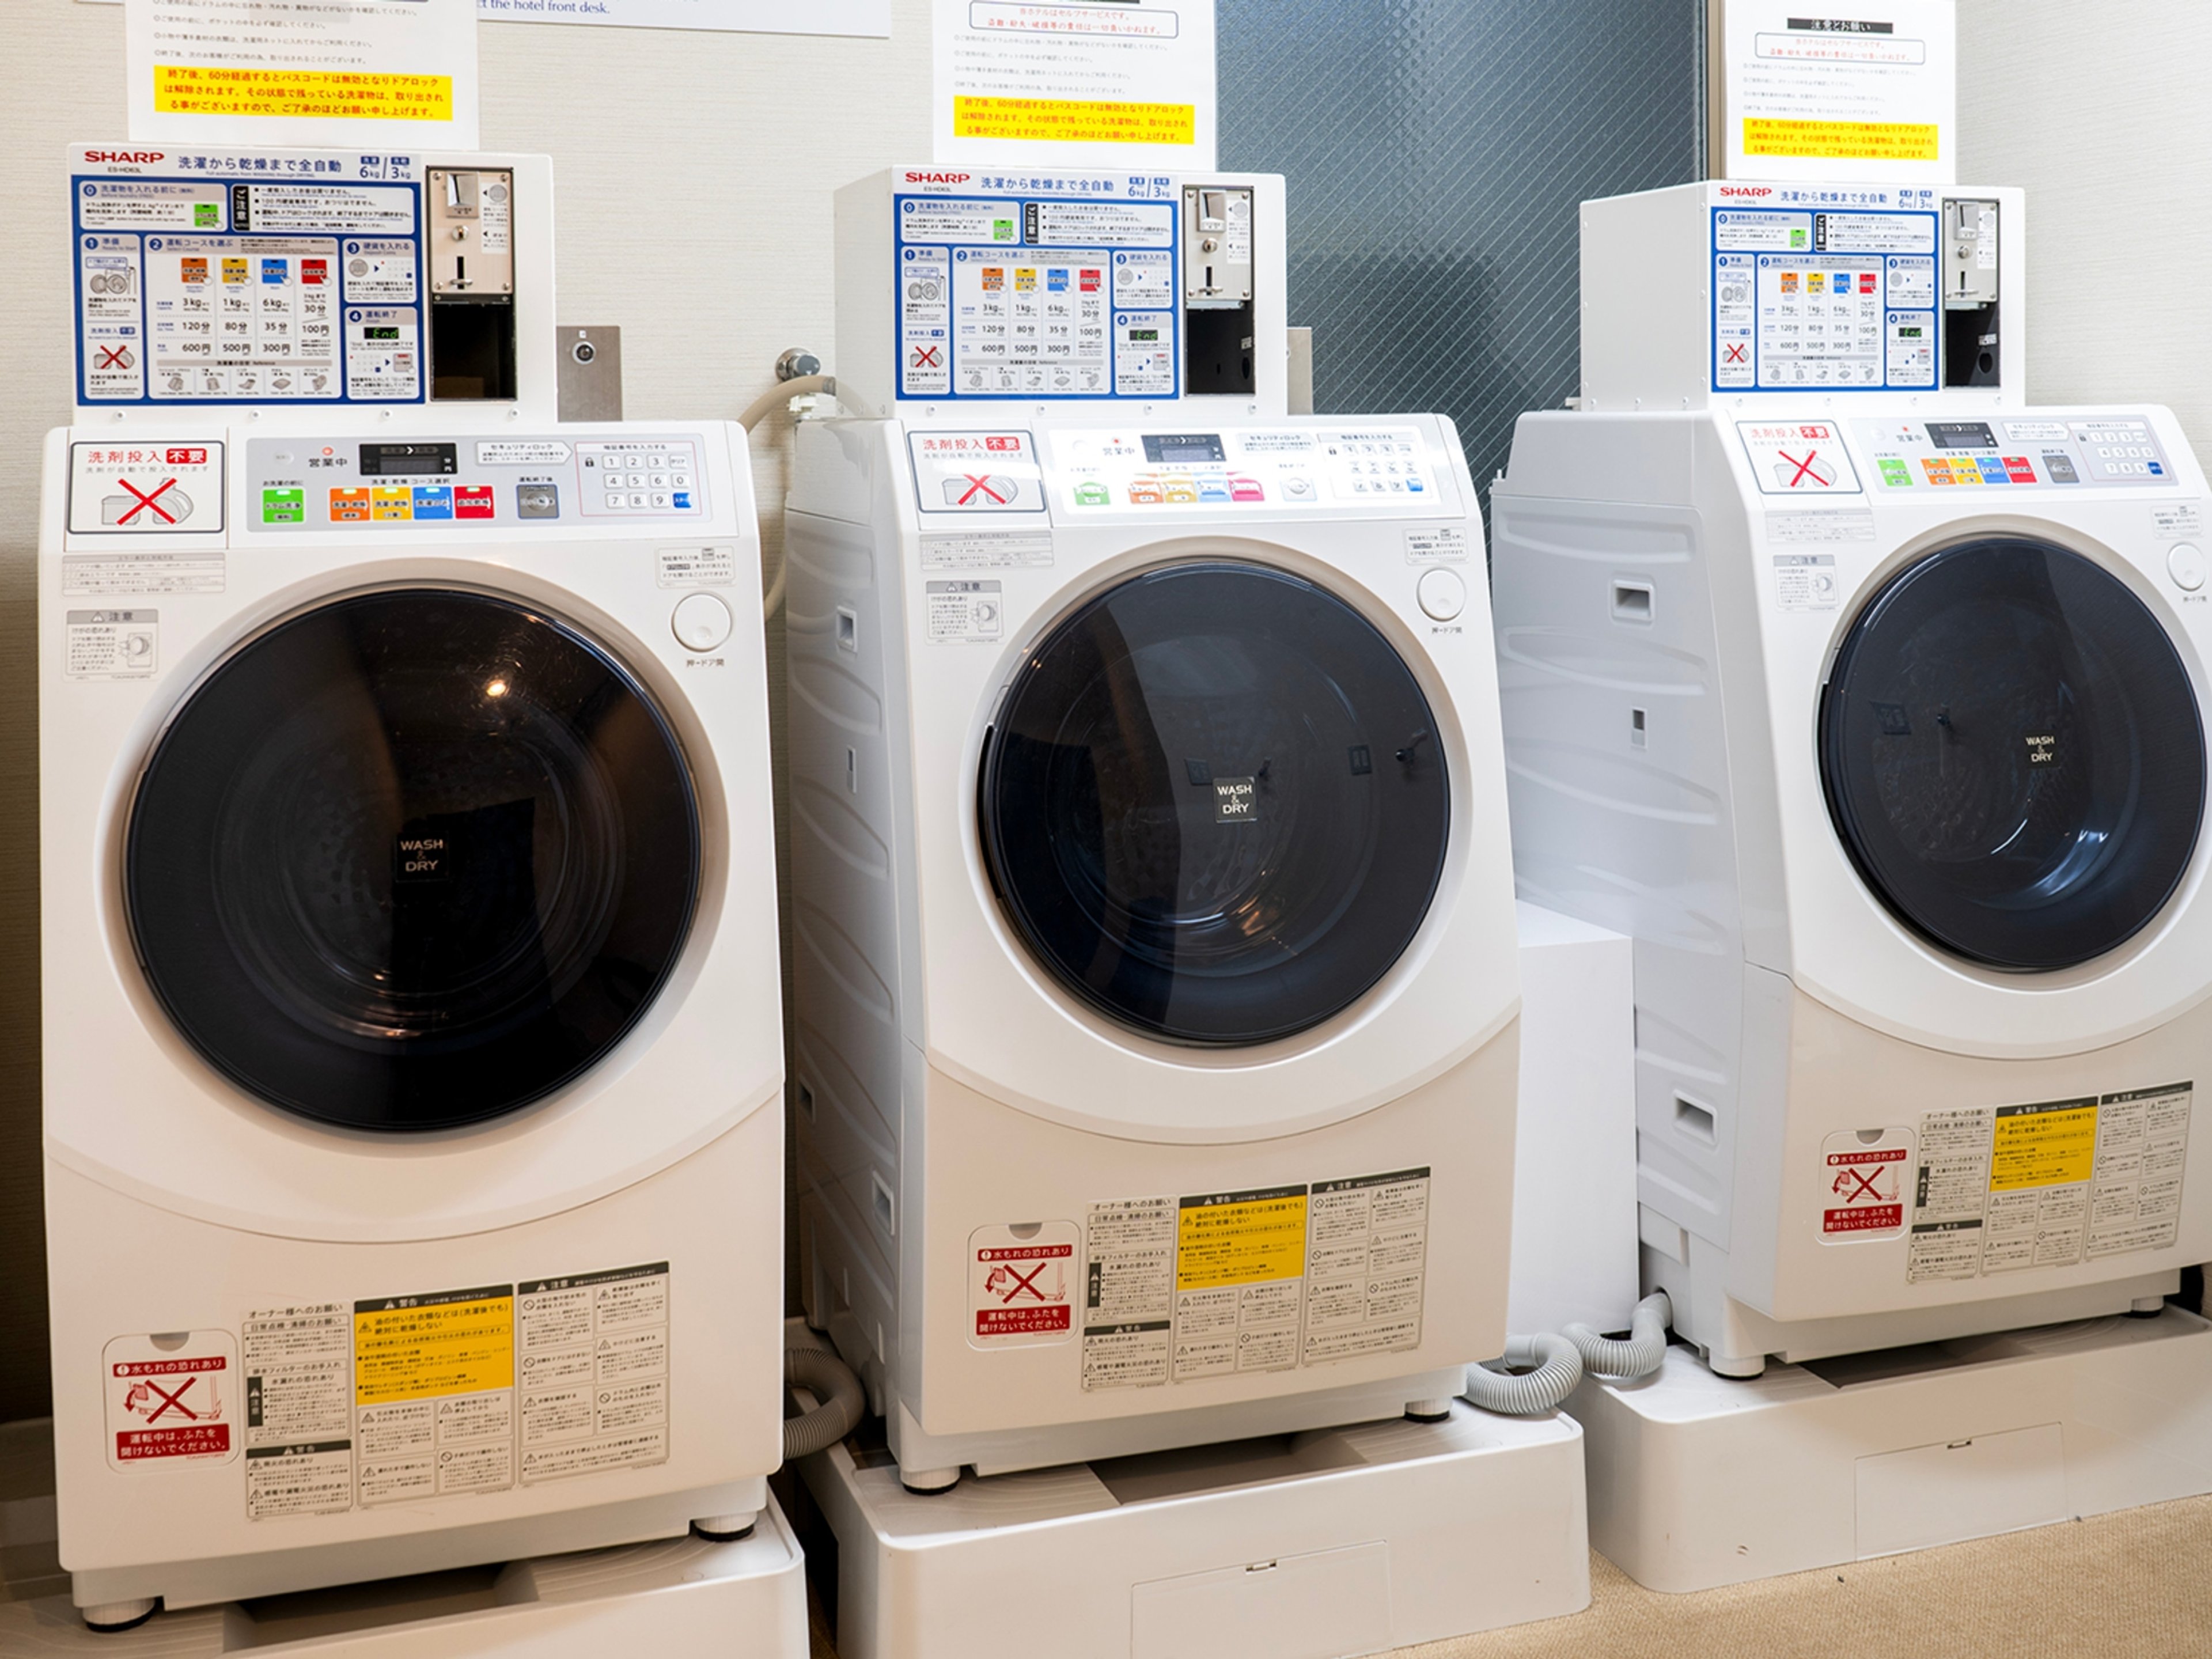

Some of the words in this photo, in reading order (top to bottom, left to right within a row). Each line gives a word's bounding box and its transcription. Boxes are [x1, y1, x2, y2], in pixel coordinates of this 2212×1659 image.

[491, 0, 510, 9] the
[515, 0, 544, 11] hotel
[548, 1, 577, 12] front
[579, 1, 610, 13] desk.
[1020, 7, 1130, 21] 当ホテルはセルフサービスです。
[1811, 19, 1871, 32] 注意とお願い
[167, 68, 438, 89] 終了後、60分経過するとパスコードは無効となりドアロック
[164, 84, 444, 103] は解除されます。その状態で残っている洗濯物は、取り出され
[169, 100, 434, 118] る事がございますので、ご了承のほどお願い申し上げます。
[85, 151, 165, 163] SHARP
[178, 156, 342, 173] 洗濯から乾燥まで全自動
[359, 165, 380, 179] 6kg
[391, 166, 411, 179] 3kg
[906, 172, 970, 184] SHARP
[101, 184, 176, 194] 洗濯物を入れる前に
[981, 177, 1114, 192] 洗濯から乾燥まで全自動
[1128, 185, 1145, 198] 6kg
[1154, 186, 1171, 198] 3kg
[1720, 187, 1772, 197] SHARP
[1781, 191, 1888, 204] 洗濯から乾燥まで全自動
[236, 190, 247, 220] ご注意
[918, 203, 979, 211] 洗濯物を入れる前に
[1027, 206, 1036, 235] ご注意
[167, 238, 233, 248] 運転コースを選ぶ
[363, 243, 410, 251] 硬貨を入れる
[304, 305, 326, 313] 30分
[366, 310, 397, 318] 運転終了
[183, 321, 210, 331] 120分
[225, 321, 247, 331] 80分
[265, 321, 287, 331] 35分
[302, 325, 329, 334] 100円
[982, 325, 1005, 334] 120分
[1017, 325, 1035, 334] 80分
[1049, 325, 1068, 334] 35分
[373, 328, 399, 339] End
[1080, 328, 1103, 338] 100円
[182, 343, 211, 354] 600円
[223, 343, 251, 354] 500円
[263, 343, 290, 354] 300円
[982, 344, 1005, 354] 600円
[1015, 344, 1038, 354] 500円
[1047, 344, 1070, 354] 300円
[923, 438, 984, 450] 洗剤投入
[88, 450, 162, 464] 洗剤投入
[169, 450, 204, 463] 不要
[308, 458, 347, 468] 営業中
[86, 465, 209, 474] 洗剤が自動で投入されます
[961, 583, 980, 591] 注意
[109, 611, 133, 622] 注意
[2025, 735, 2055, 745] WASH
[2031, 753, 2054, 763] DRY
[1217, 785, 1252, 796] WASH
[1230, 794, 1240, 804] &
[1222, 802, 1249, 815] DRY
[400, 839, 444, 851] WASH
[405, 859, 439, 872] DRY
[1839, 1152, 1904, 1164] 水もれの恐れあり
[1094, 1198, 1171, 1210] オーナー様へのお願い
[1216, 1195, 1231, 1203] 警告
[1834, 1208, 1894, 1219] 運転中は、ふたを
[1825, 1218, 1899, 1230] 開けないでください。
[993, 1247, 1069, 1259] 水もれの恐れあり
[551, 1279, 569, 1289] 注意
[399, 1298, 418, 1308] 警告
[249, 1304, 343, 1319] オーナー様へのお願い
[988, 1309, 1060, 1321] 運転中は、ふたを
[375, 1321, 443, 1335] 絶対に乾燥しない
[979, 1319, 1067, 1333] 開けないでください。
[131, 1359, 222, 1374] 水もれの恐れあり
[130, 1428, 216, 1445] 運転中は、ふたを
[120, 1442, 226, 1458] 開けないでください。
